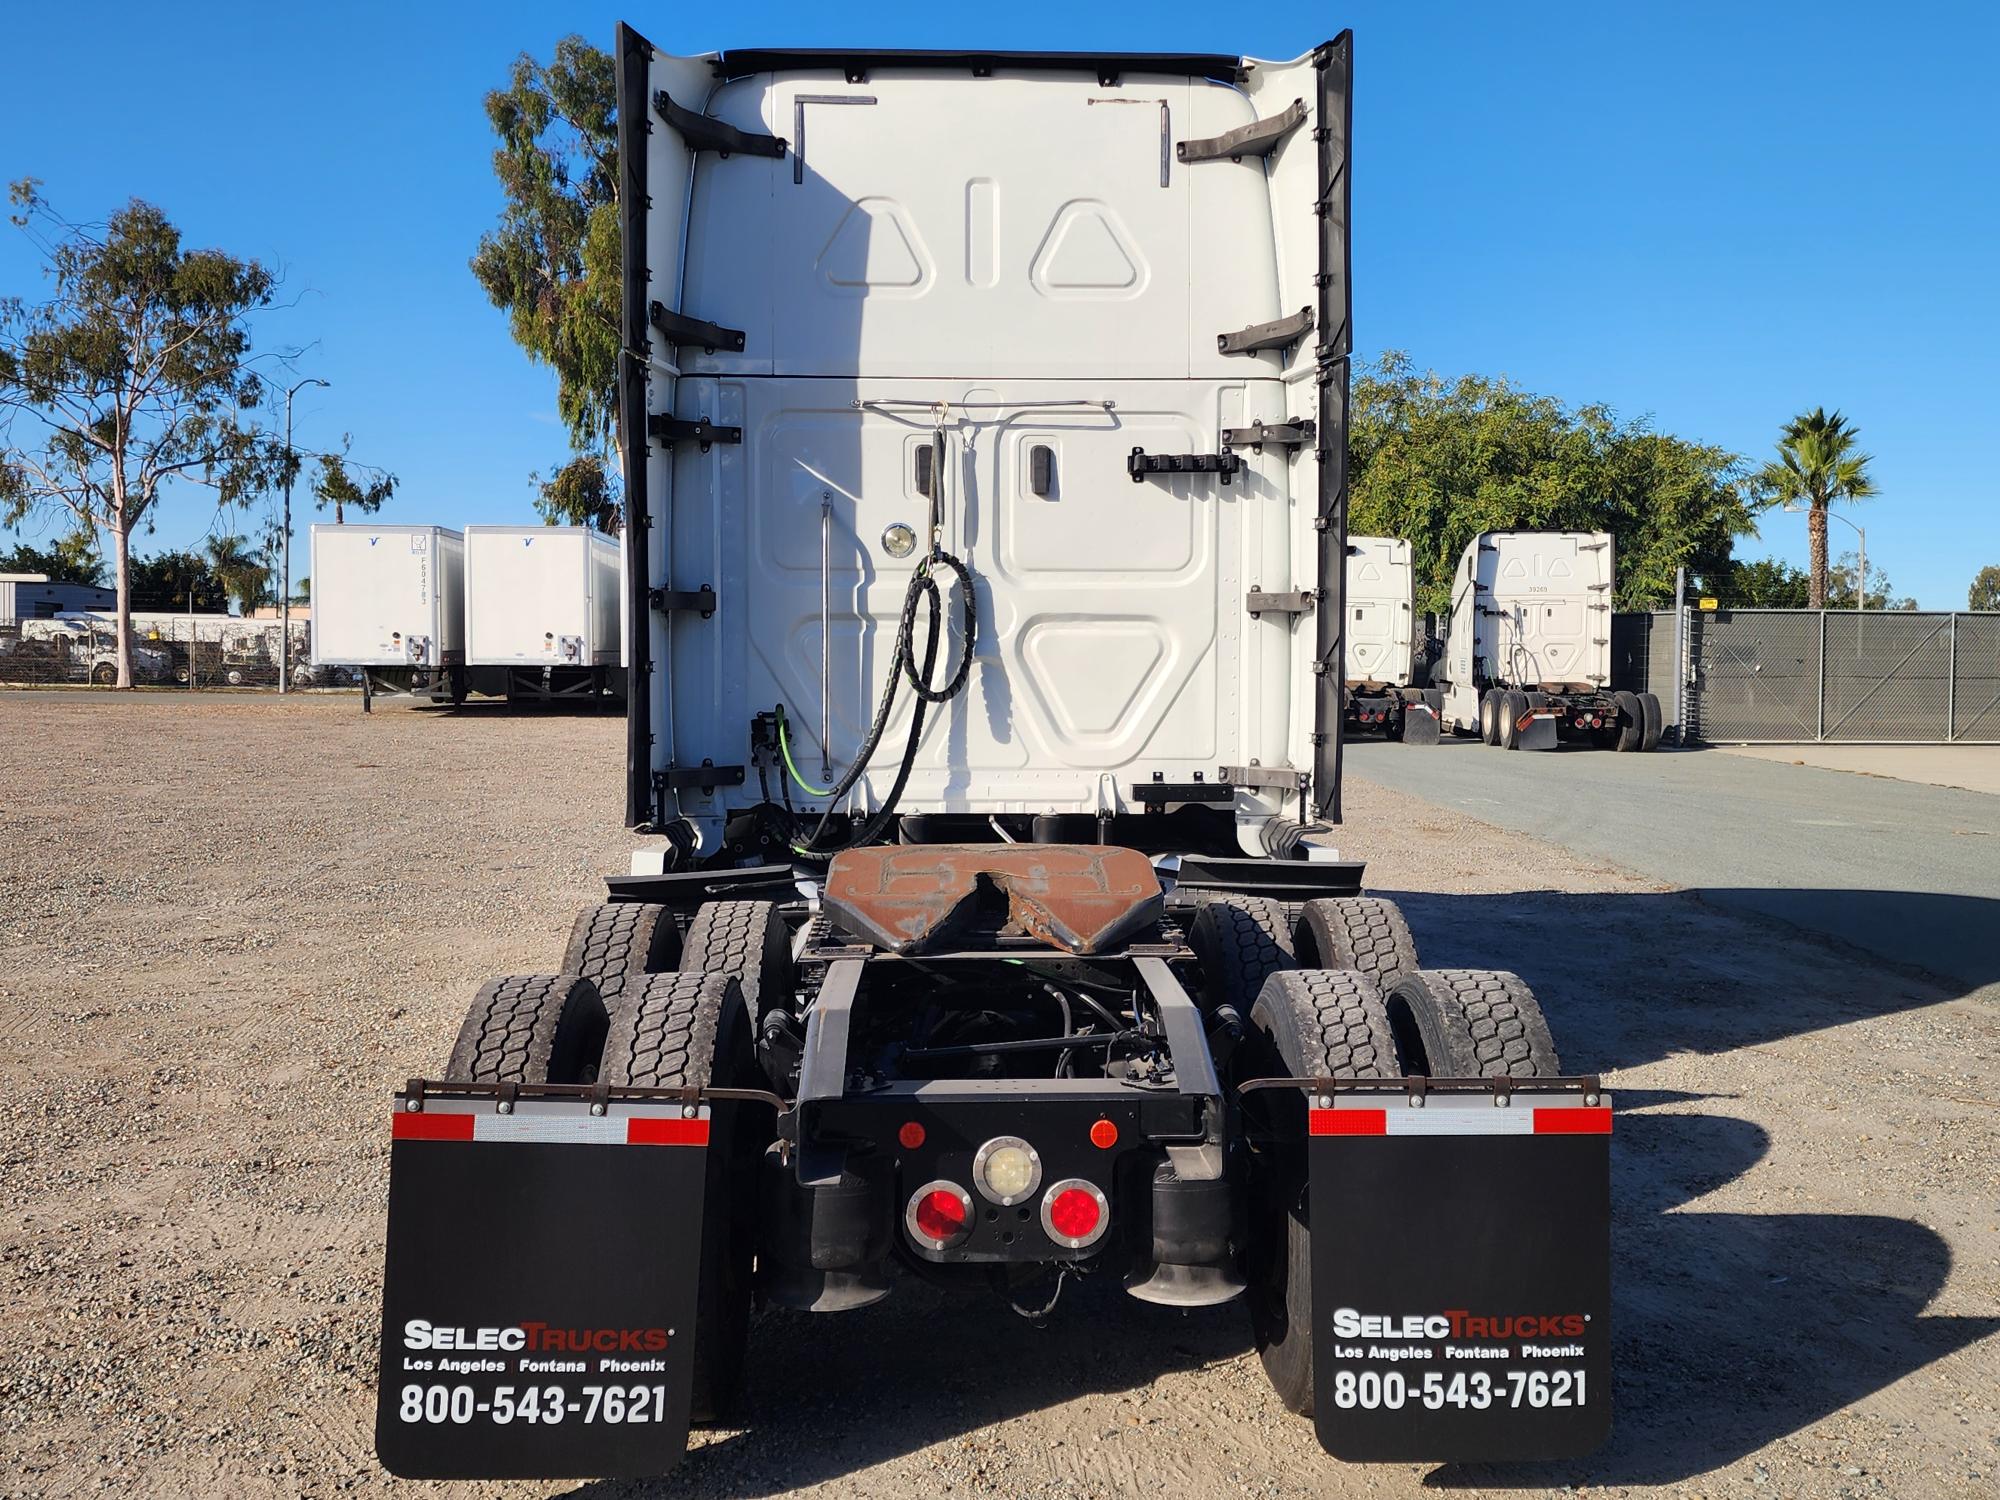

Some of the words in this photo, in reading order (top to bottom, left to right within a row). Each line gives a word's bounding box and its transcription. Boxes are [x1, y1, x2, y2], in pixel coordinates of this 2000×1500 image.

[403, 1357, 434, 1371] Los
[438, 1358, 506, 1374] Angeles
[519, 1359, 587, 1373] Fontana
[599, 1359, 666, 1373] Phoenix
[1334, 1345, 1364, 1359] Los
[1368, 1345, 1433, 1361] Angeles
[1445, 1346, 1510, 1359] Fontana
[1521, 1344, 1585, 1358] Phoenix
[1334, 1370, 1586, 1409] 800-543-7621
[399, 1384, 666, 1424] 800-543-7621
